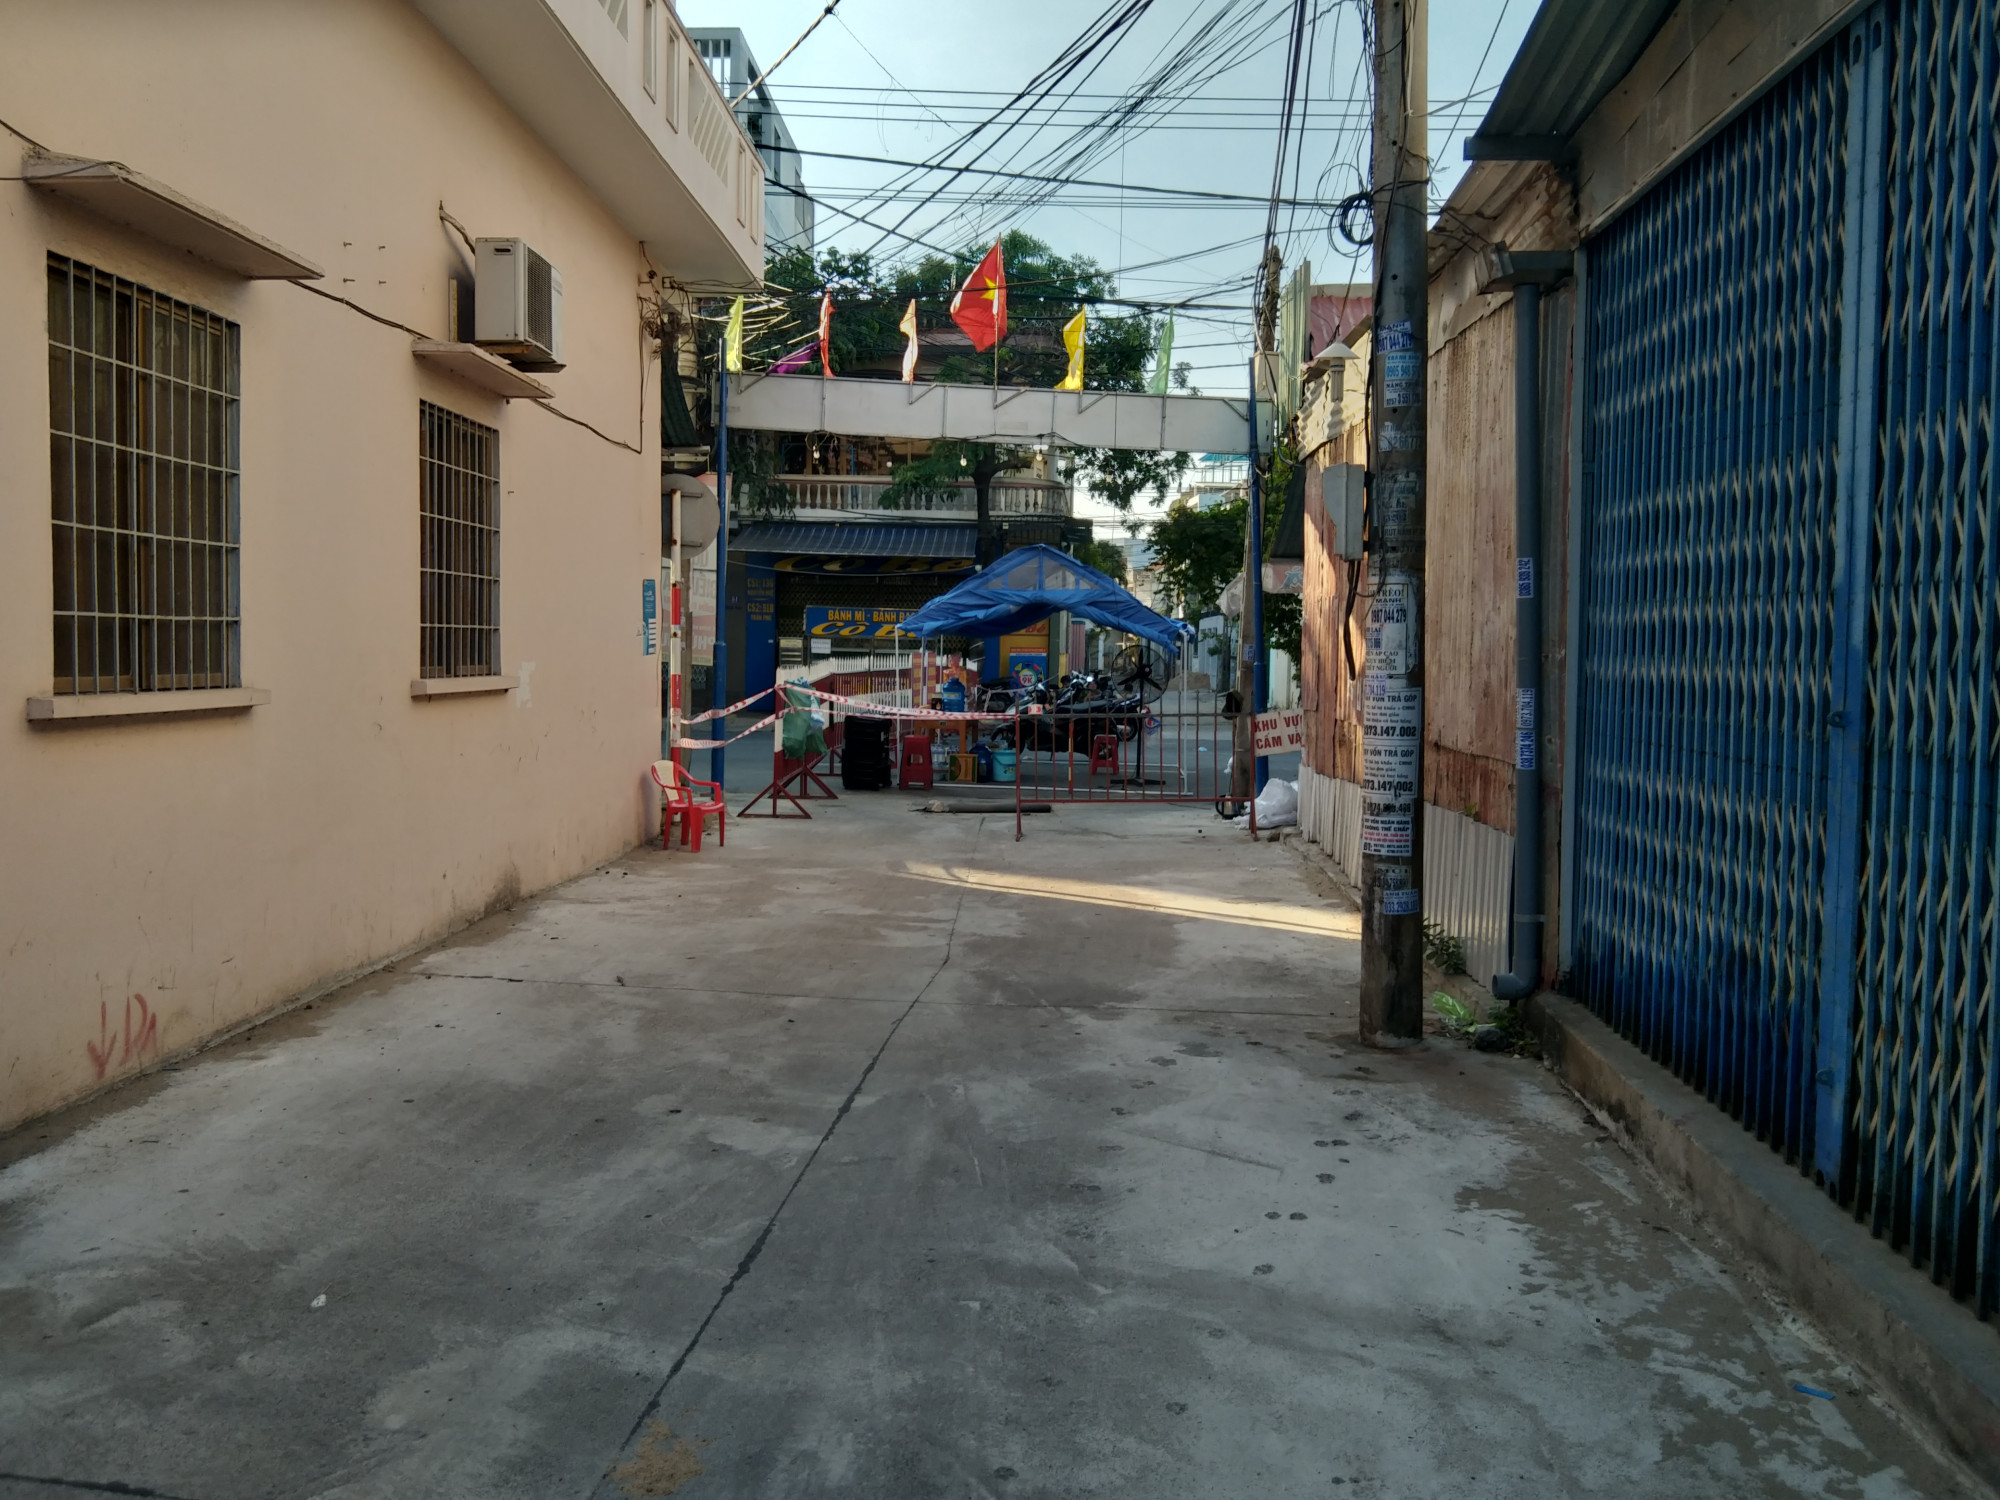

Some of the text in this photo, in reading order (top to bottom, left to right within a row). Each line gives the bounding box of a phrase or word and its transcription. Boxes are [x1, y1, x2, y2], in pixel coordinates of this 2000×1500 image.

[828, 608, 852, 621] BÁNH
[1384, 609, 1395, 623] 044
[1396, 609, 1407, 623] 279
[811, 621, 870, 636] Cô
[1022, 676, 1033, 684] 9K
[1387, 693, 1402, 702] TRẢ
[1404, 693, 1418, 703] GÓP
[1254, 719, 1277, 733] KHU
[1256, 732, 1282, 750] CẤM
[1370, 746, 1381, 756] VỐN
[1384, 747, 1398, 757] TRẢ
[1401, 748, 1415, 757] GÓP
